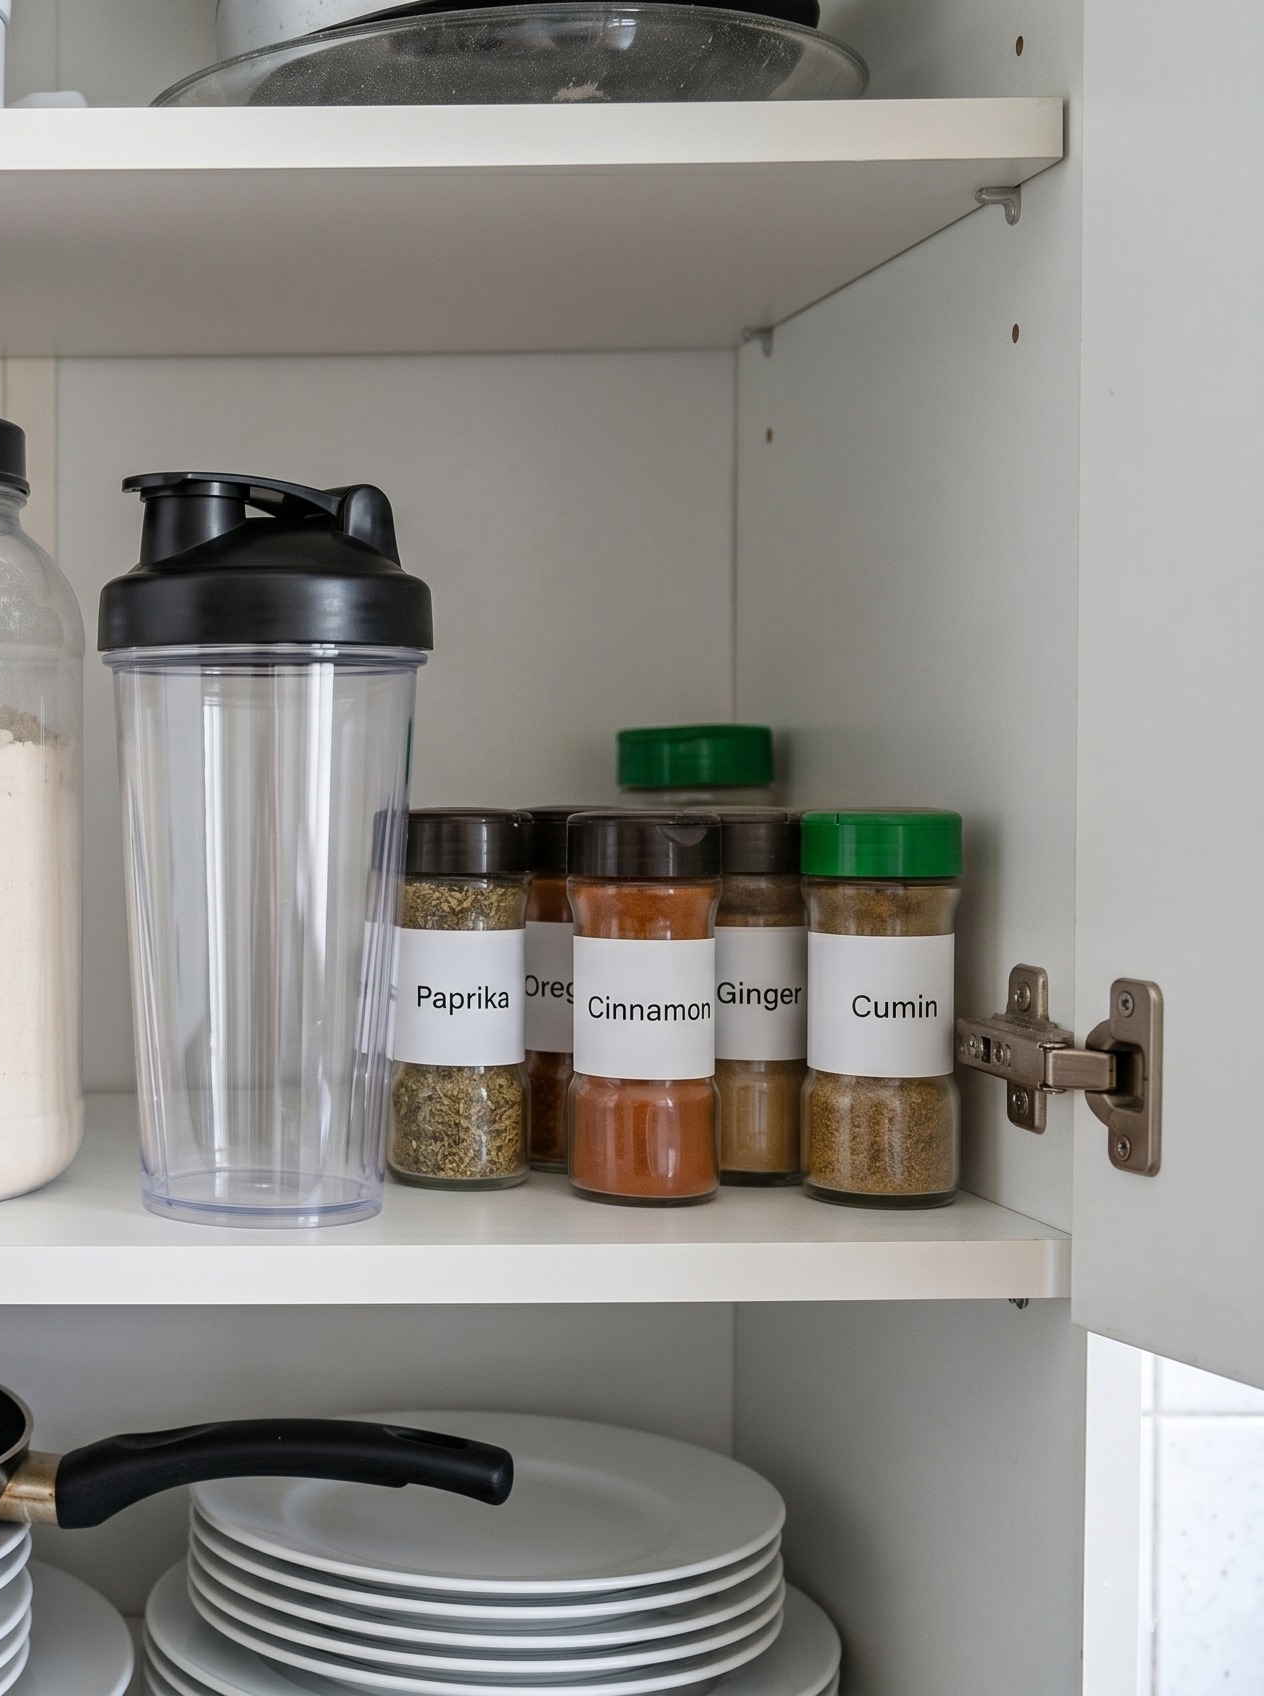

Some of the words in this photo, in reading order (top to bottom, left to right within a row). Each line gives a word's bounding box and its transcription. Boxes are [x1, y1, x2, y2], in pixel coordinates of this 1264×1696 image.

[417, 985, 510, 1015] Paprika
[588, 995, 712, 1022] Cinnamon
[716, 981, 803, 1012] Ginger
[851, 994, 938, 1019] Cumin
